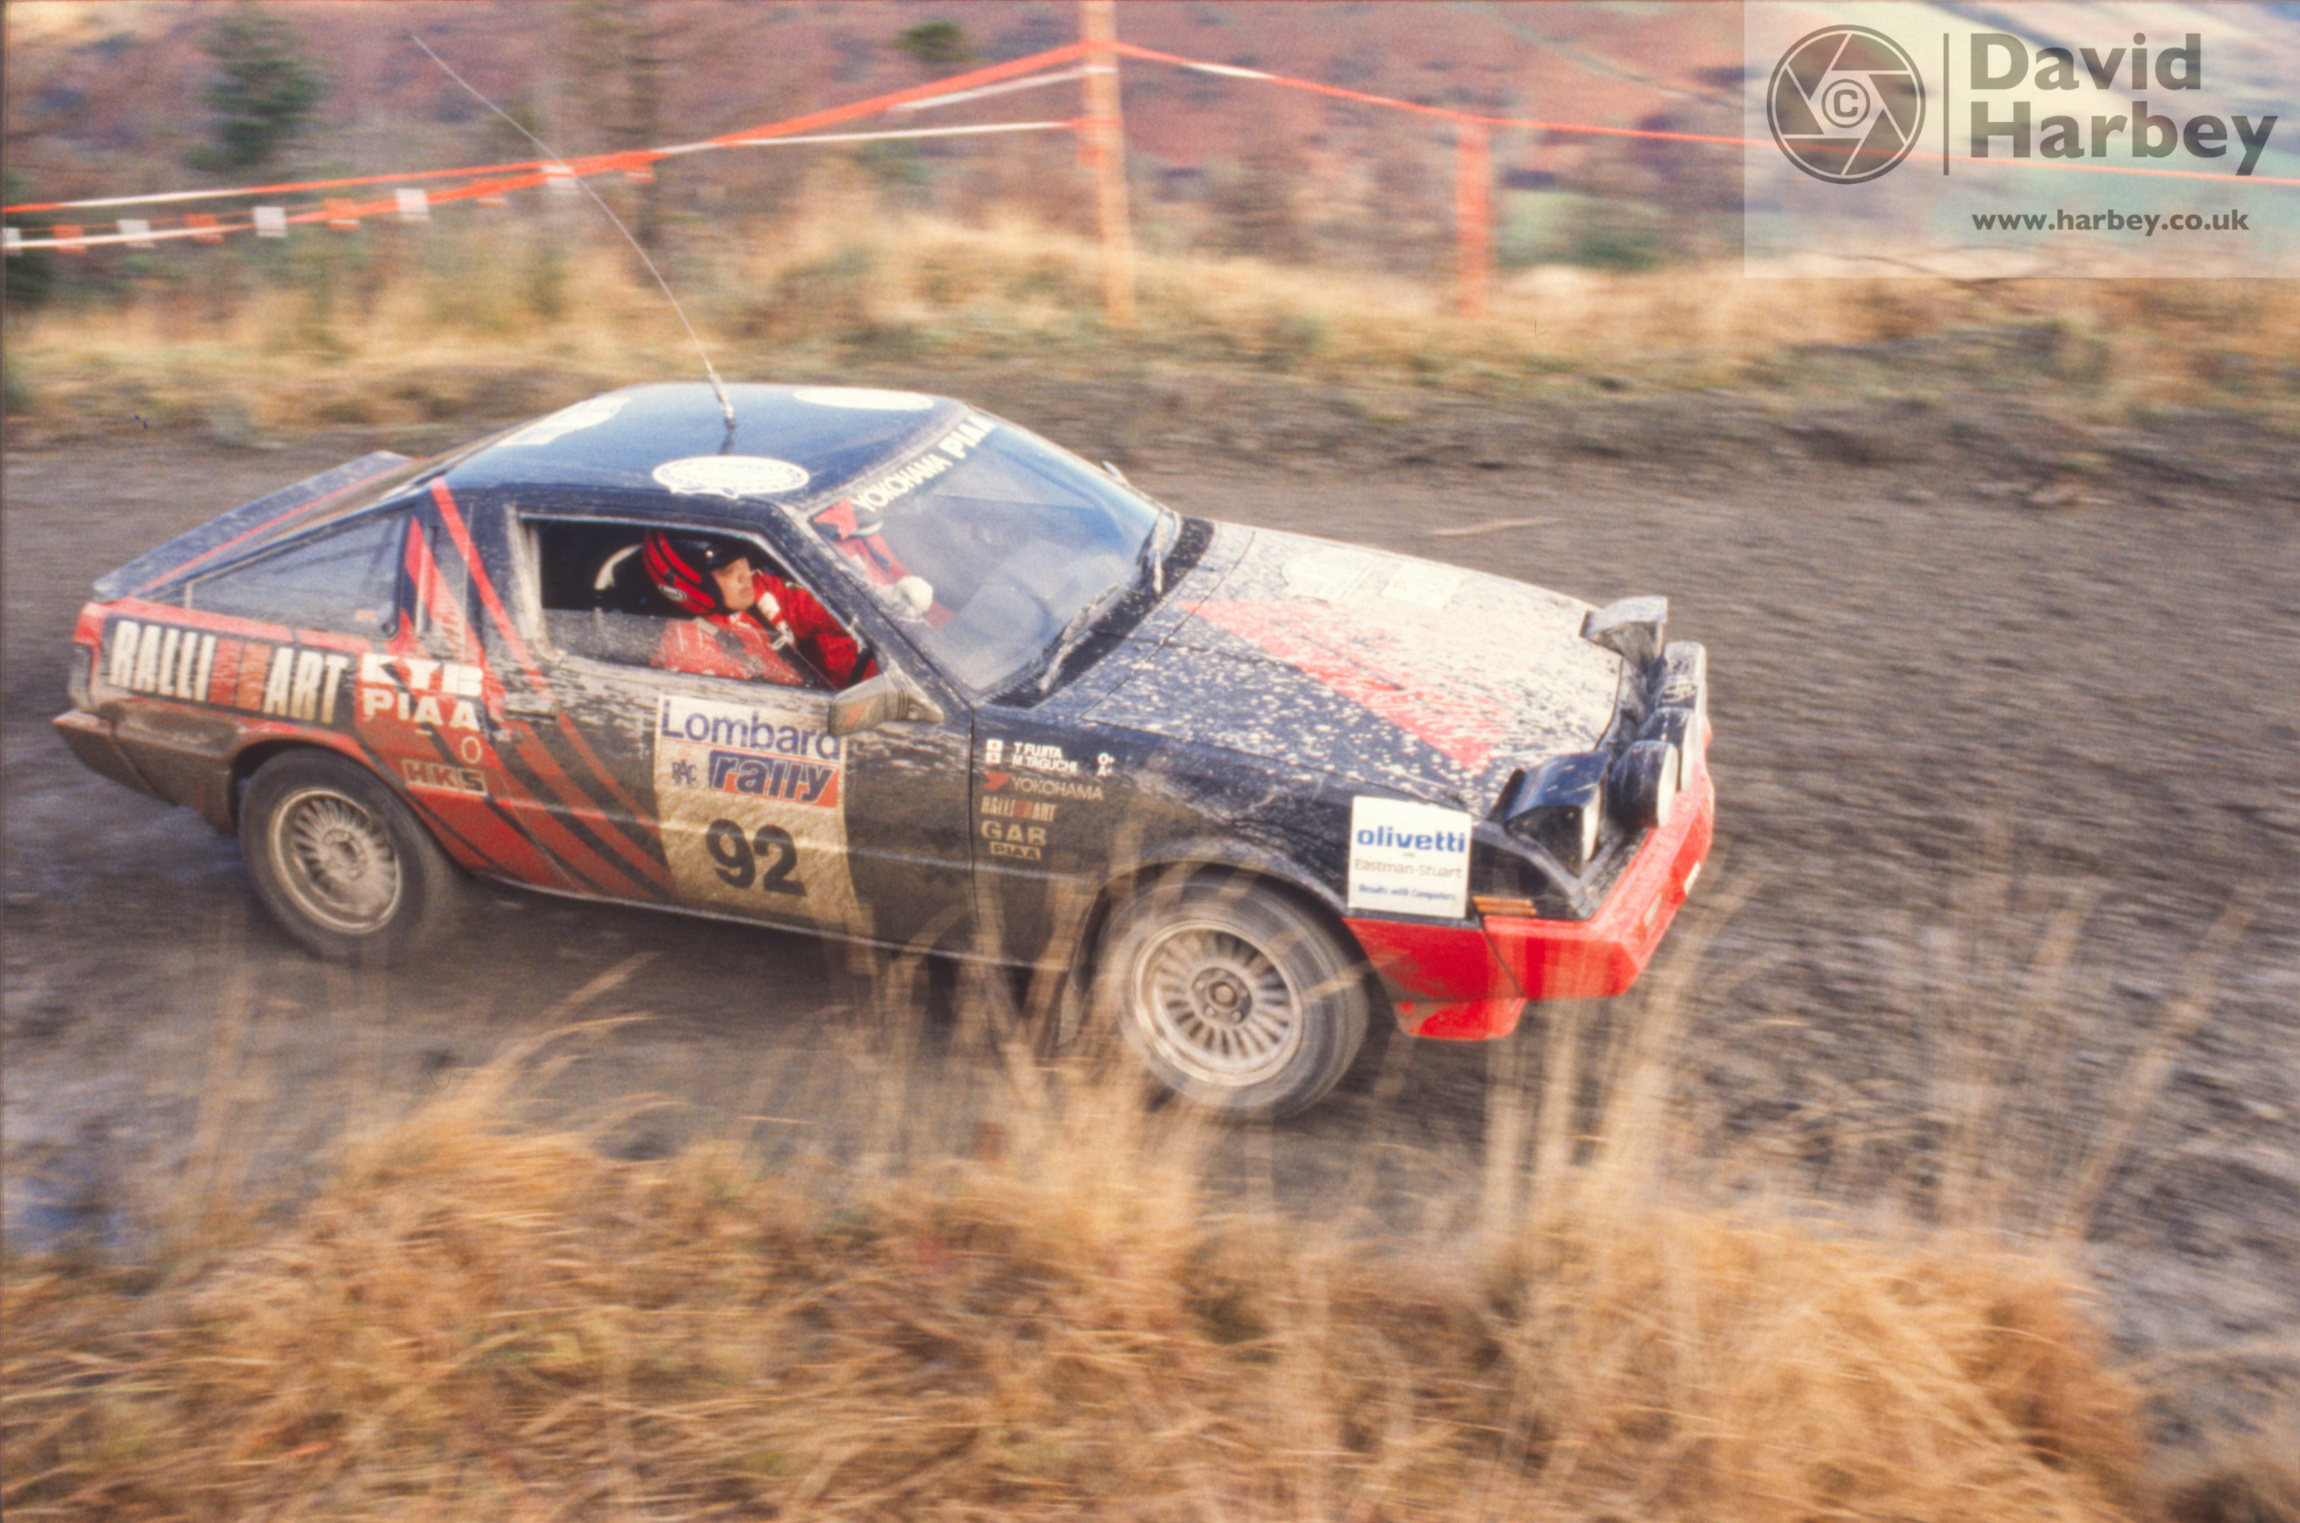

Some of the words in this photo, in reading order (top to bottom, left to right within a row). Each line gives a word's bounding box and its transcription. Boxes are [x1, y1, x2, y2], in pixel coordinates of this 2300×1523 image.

[851, 453, 953, 513] YOKOHAMA
[361, 652, 483, 697] KYB
[363, 687, 481, 732] PIAA
[661, 699, 841, 761] Lombard
[404, 759, 488, 795] HKS
[711, 756, 834, 803] rally
[1012, 776, 1104, 801] YOKOHAMA
[705, 818, 808, 897] 92
[1357, 826, 1465, 853] olivetti
[1354, 858, 1462, 878] Eastman-Stuart
